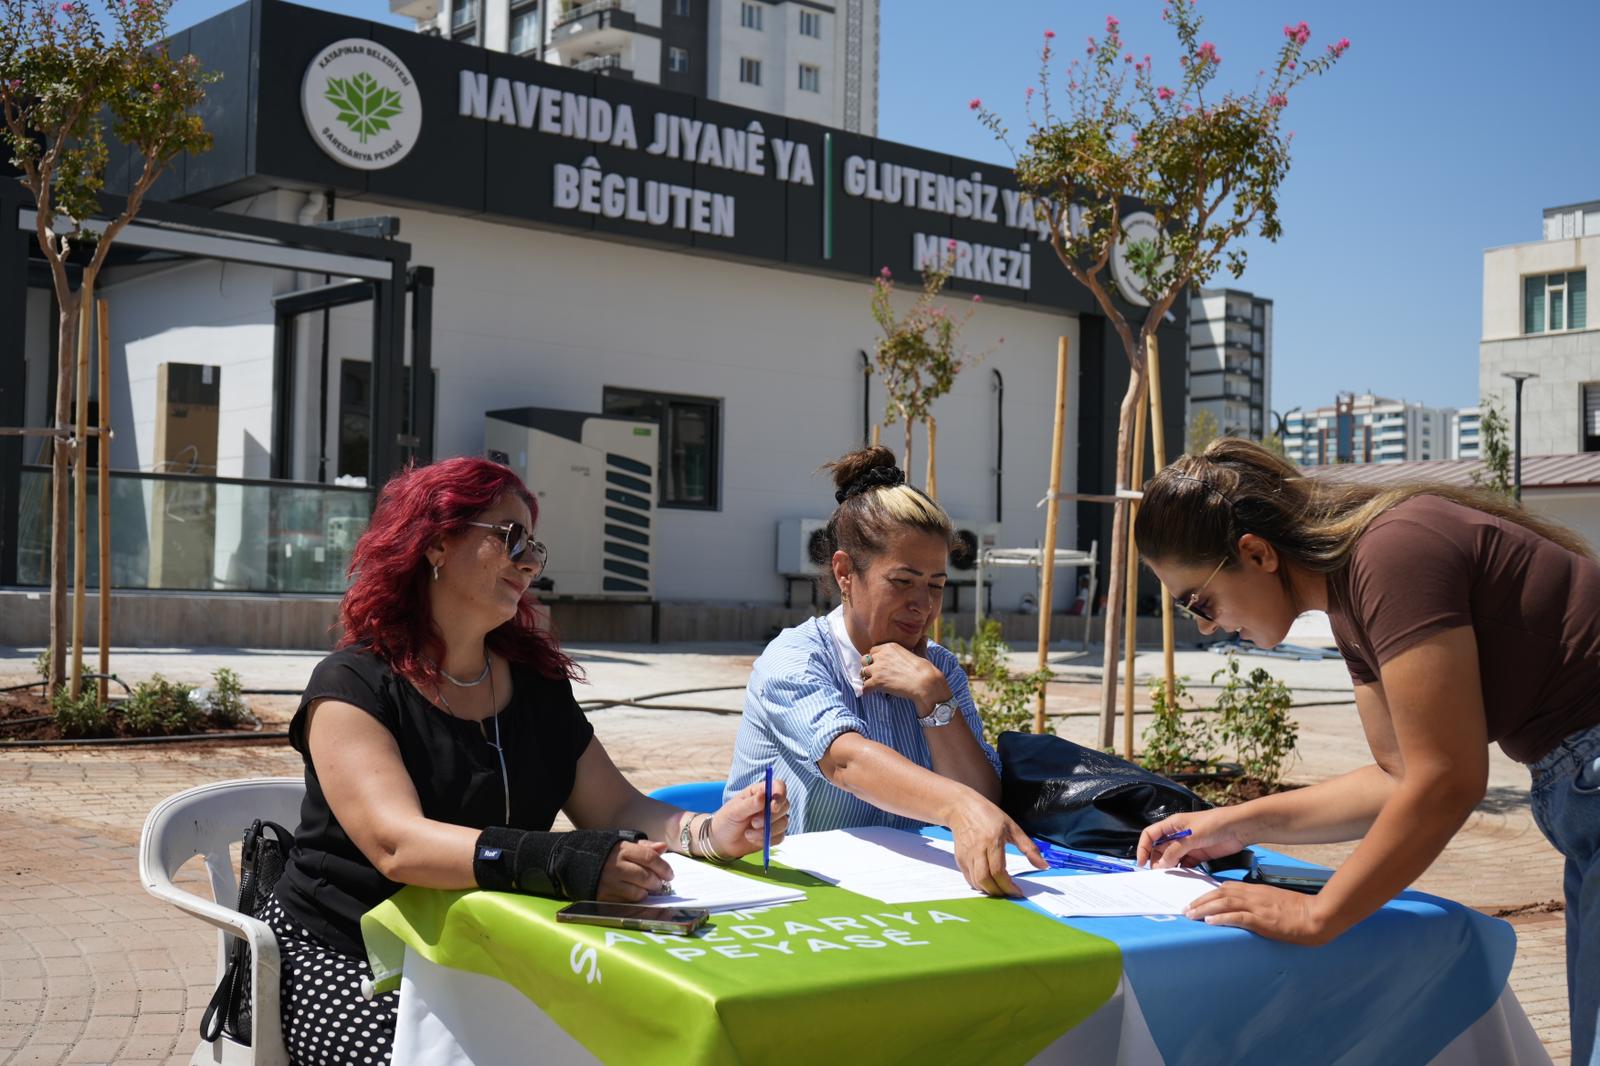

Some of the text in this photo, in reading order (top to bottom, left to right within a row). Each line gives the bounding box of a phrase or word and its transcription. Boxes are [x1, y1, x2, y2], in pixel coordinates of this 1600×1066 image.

[459, 70, 814, 186] NAVENDA JIYANÊ YA
[553, 156, 735, 238] BÊGLUTEN
[844, 155, 998, 223] GLUTENSİZ
[913, 232, 1031, 290] MERKEZİ
